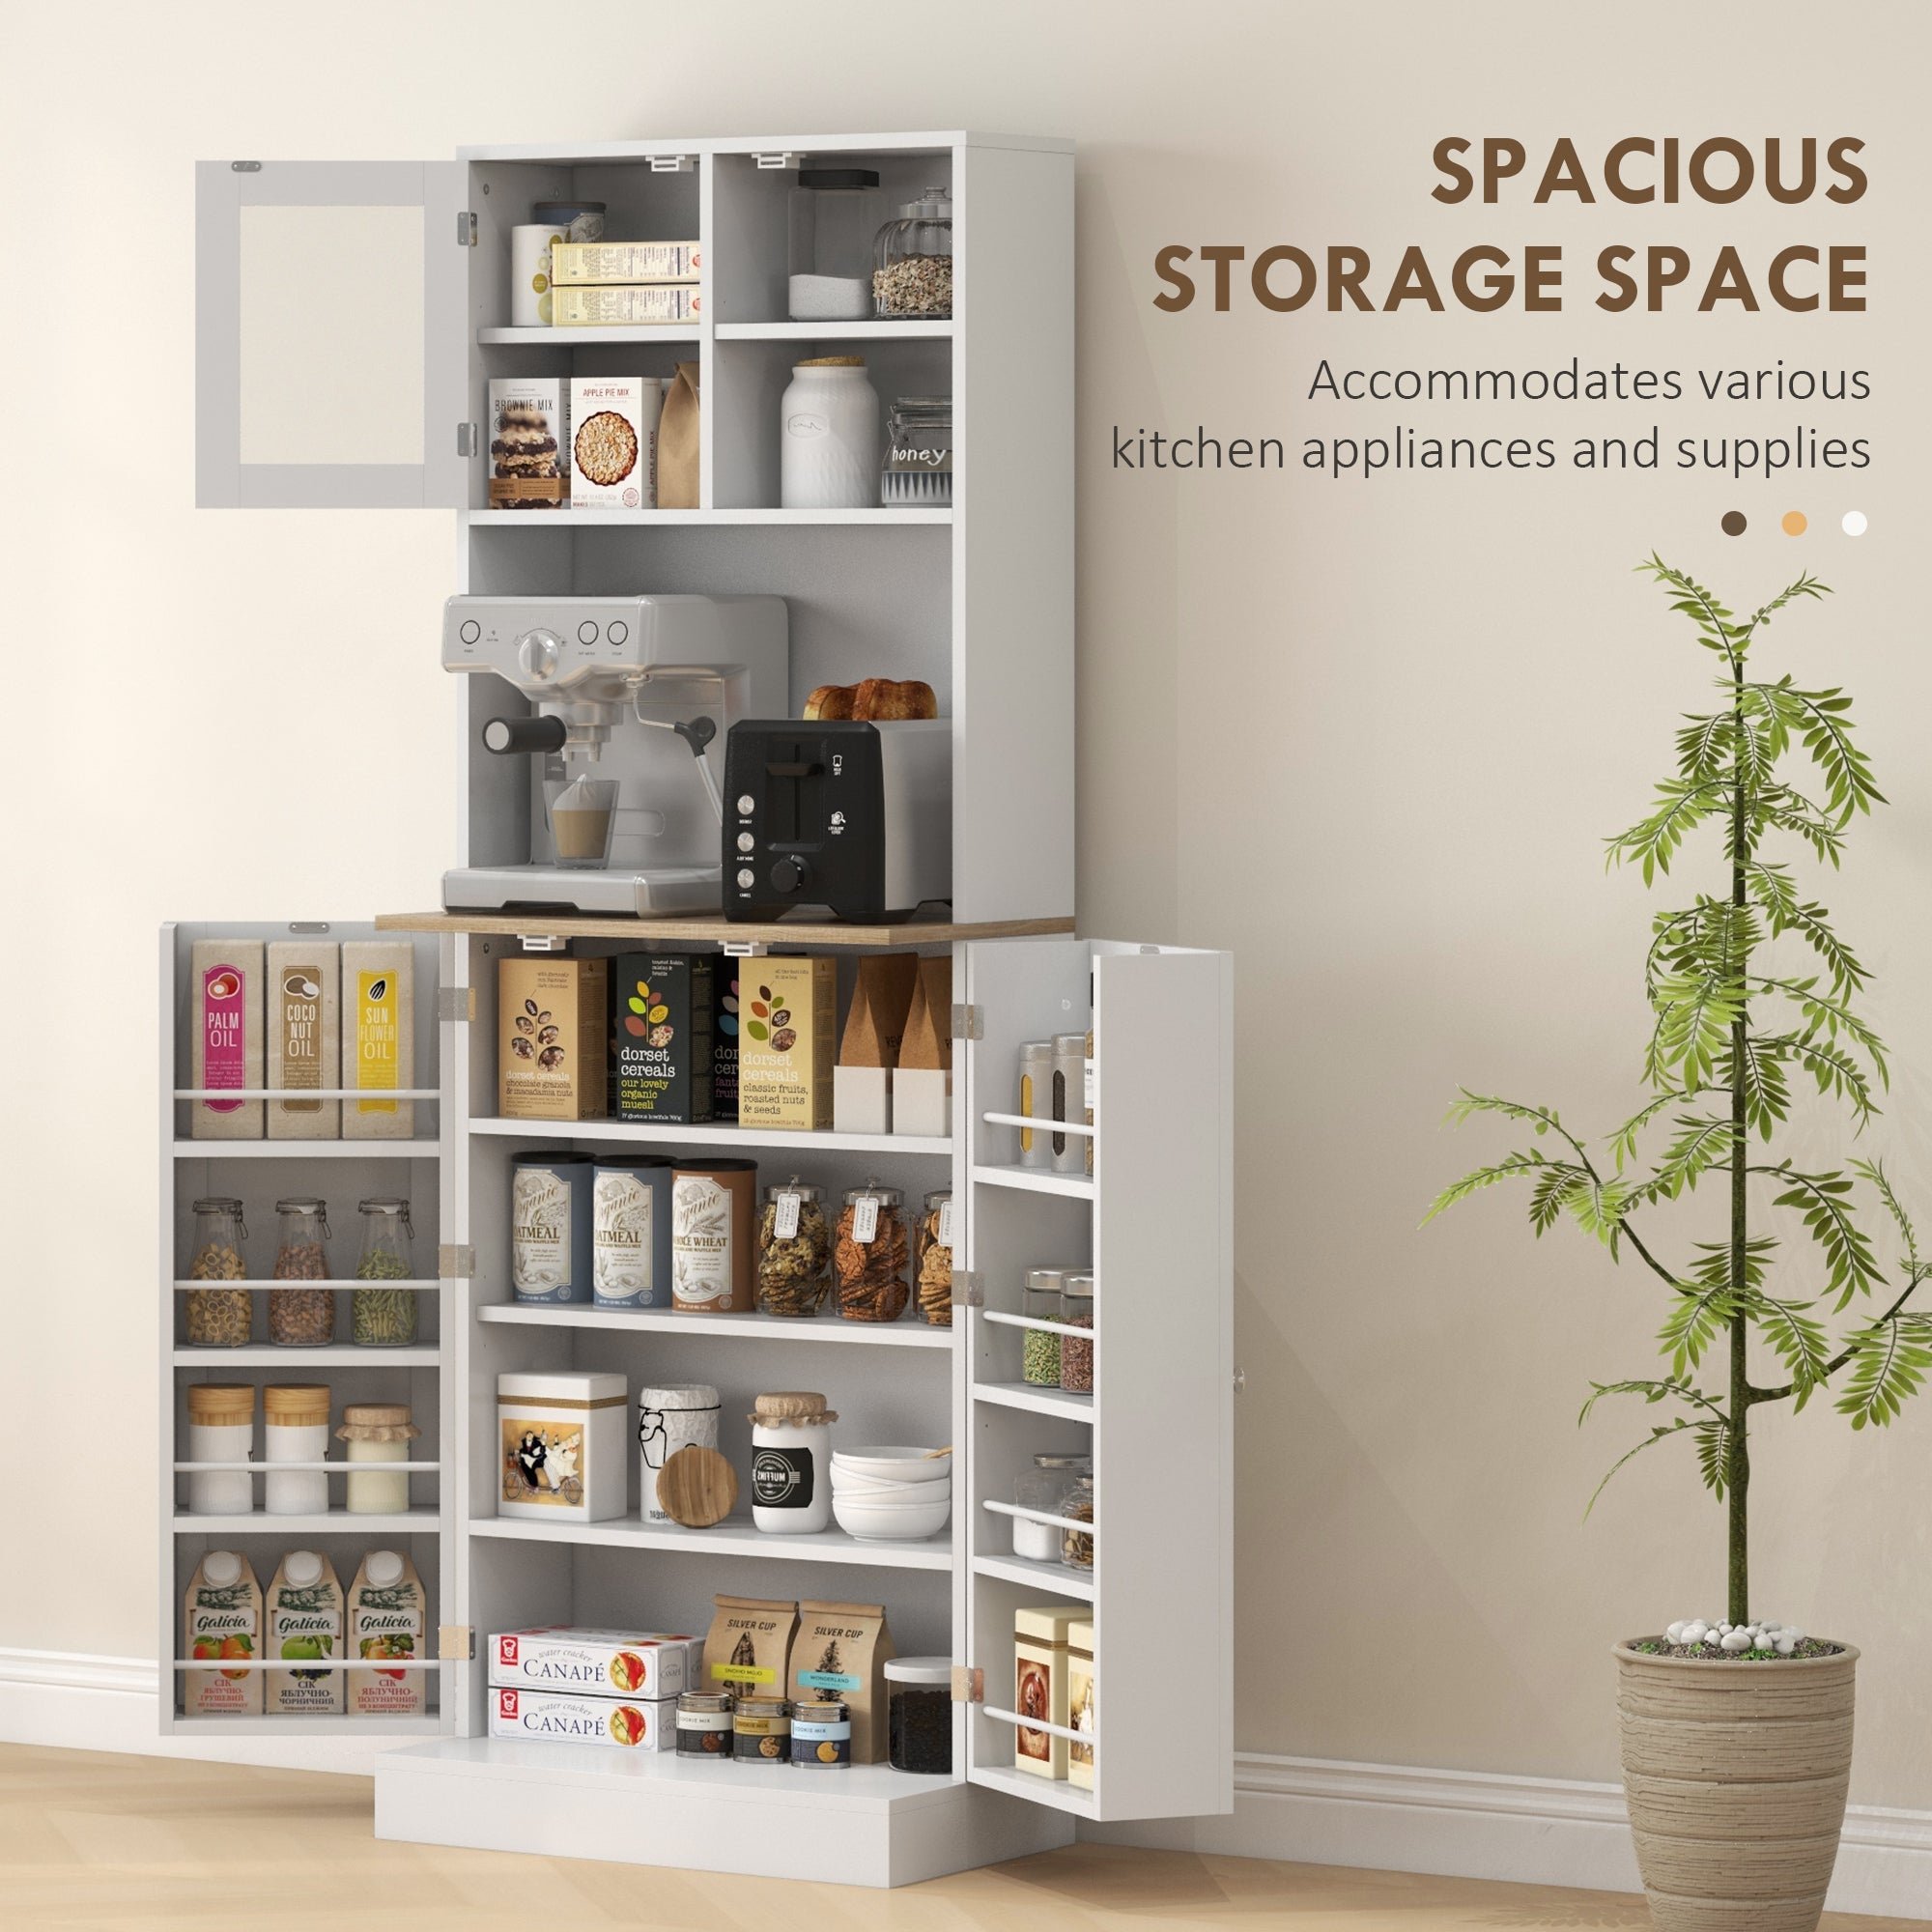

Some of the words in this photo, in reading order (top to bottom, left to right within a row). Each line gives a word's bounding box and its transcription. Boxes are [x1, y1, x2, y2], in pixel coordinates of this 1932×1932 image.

[582, 388, 604, 397] APPLE
[605, 388, 616, 397] PIE
[495, 399, 533, 412] BROWNIE
[537, 398, 554, 412] MIX
[892, 445, 947, 467] honey
[287, 1004, 316, 1022] COCO
[365, 1007, 388, 1024] SUN
[208, 1011, 240, 1030] PALM
[291, 1022, 313, 1039] NUT
[360, 1024, 395, 1042] FLOWER
[210, 1030, 238, 1048] OIL
[288, 1039, 315, 1058] OIL
[364, 1042, 391, 1060] OIL
[621, 1047, 670, 1063] dorset
[742, 1051, 793, 1066] dorset
[505, 1070, 535, 1080] dorset
[536, 1071, 570, 1082] cereals
[621, 1063, 676, 1078] cereals
[742, 1066, 799, 1082] cereals
[505, 1079, 541, 1089] chocolate
[542, 1081, 571, 1090] granola
[621, 1079, 639, 1088] our
[639, 1078, 668, 1091] lovely
[743, 1083, 777, 1094] classic
[779, 1084, 809, 1095] fruits,
[621, 1089, 658, 1100] organic
[743, 1094, 781, 1104] roasted
[782, 1095, 806, 1105] nuts
[621, 1099, 654, 1110] muesli
[743, 1104, 753, 1114] &
[753, 1104, 781, 1115] seeds
[693, 1236, 728, 1248] WHEAT
[197, 1615, 250, 1632] Galicia
[278, 1617, 334, 1634] Galicia
[360, 1615, 416, 1633] Galicia
[727, 1619, 756, 1631] SILVER
[758, 1622, 777, 1632] CUP
[814, 1627, 843, 1637] SILVER
[844, 1629, 864, 1639] CUP
[538, 1649, 561, 1659] water
[562, 1649, 593, 1662] cracker
[524, 1658, 606, 1683] CANAPÉ
[214, 1679, 232, 1688] СІК
[379, 1679, 396, 1688] СІК
[810, 1674, 850, 1684] WONDERLAND
[280, 1689, 332, 1697] ЯБЛУЧНО-
[361, 1688, 413, 1696] ЯБЛУЧНО-
[278, 1696, 334, 1706] ЧОРНИЧНИЙ
[538, 1703, 561, 1712] water
[562, 1702, 593, 1716] cracker
[524, 1712, 606, 1737] CANAPÉ
